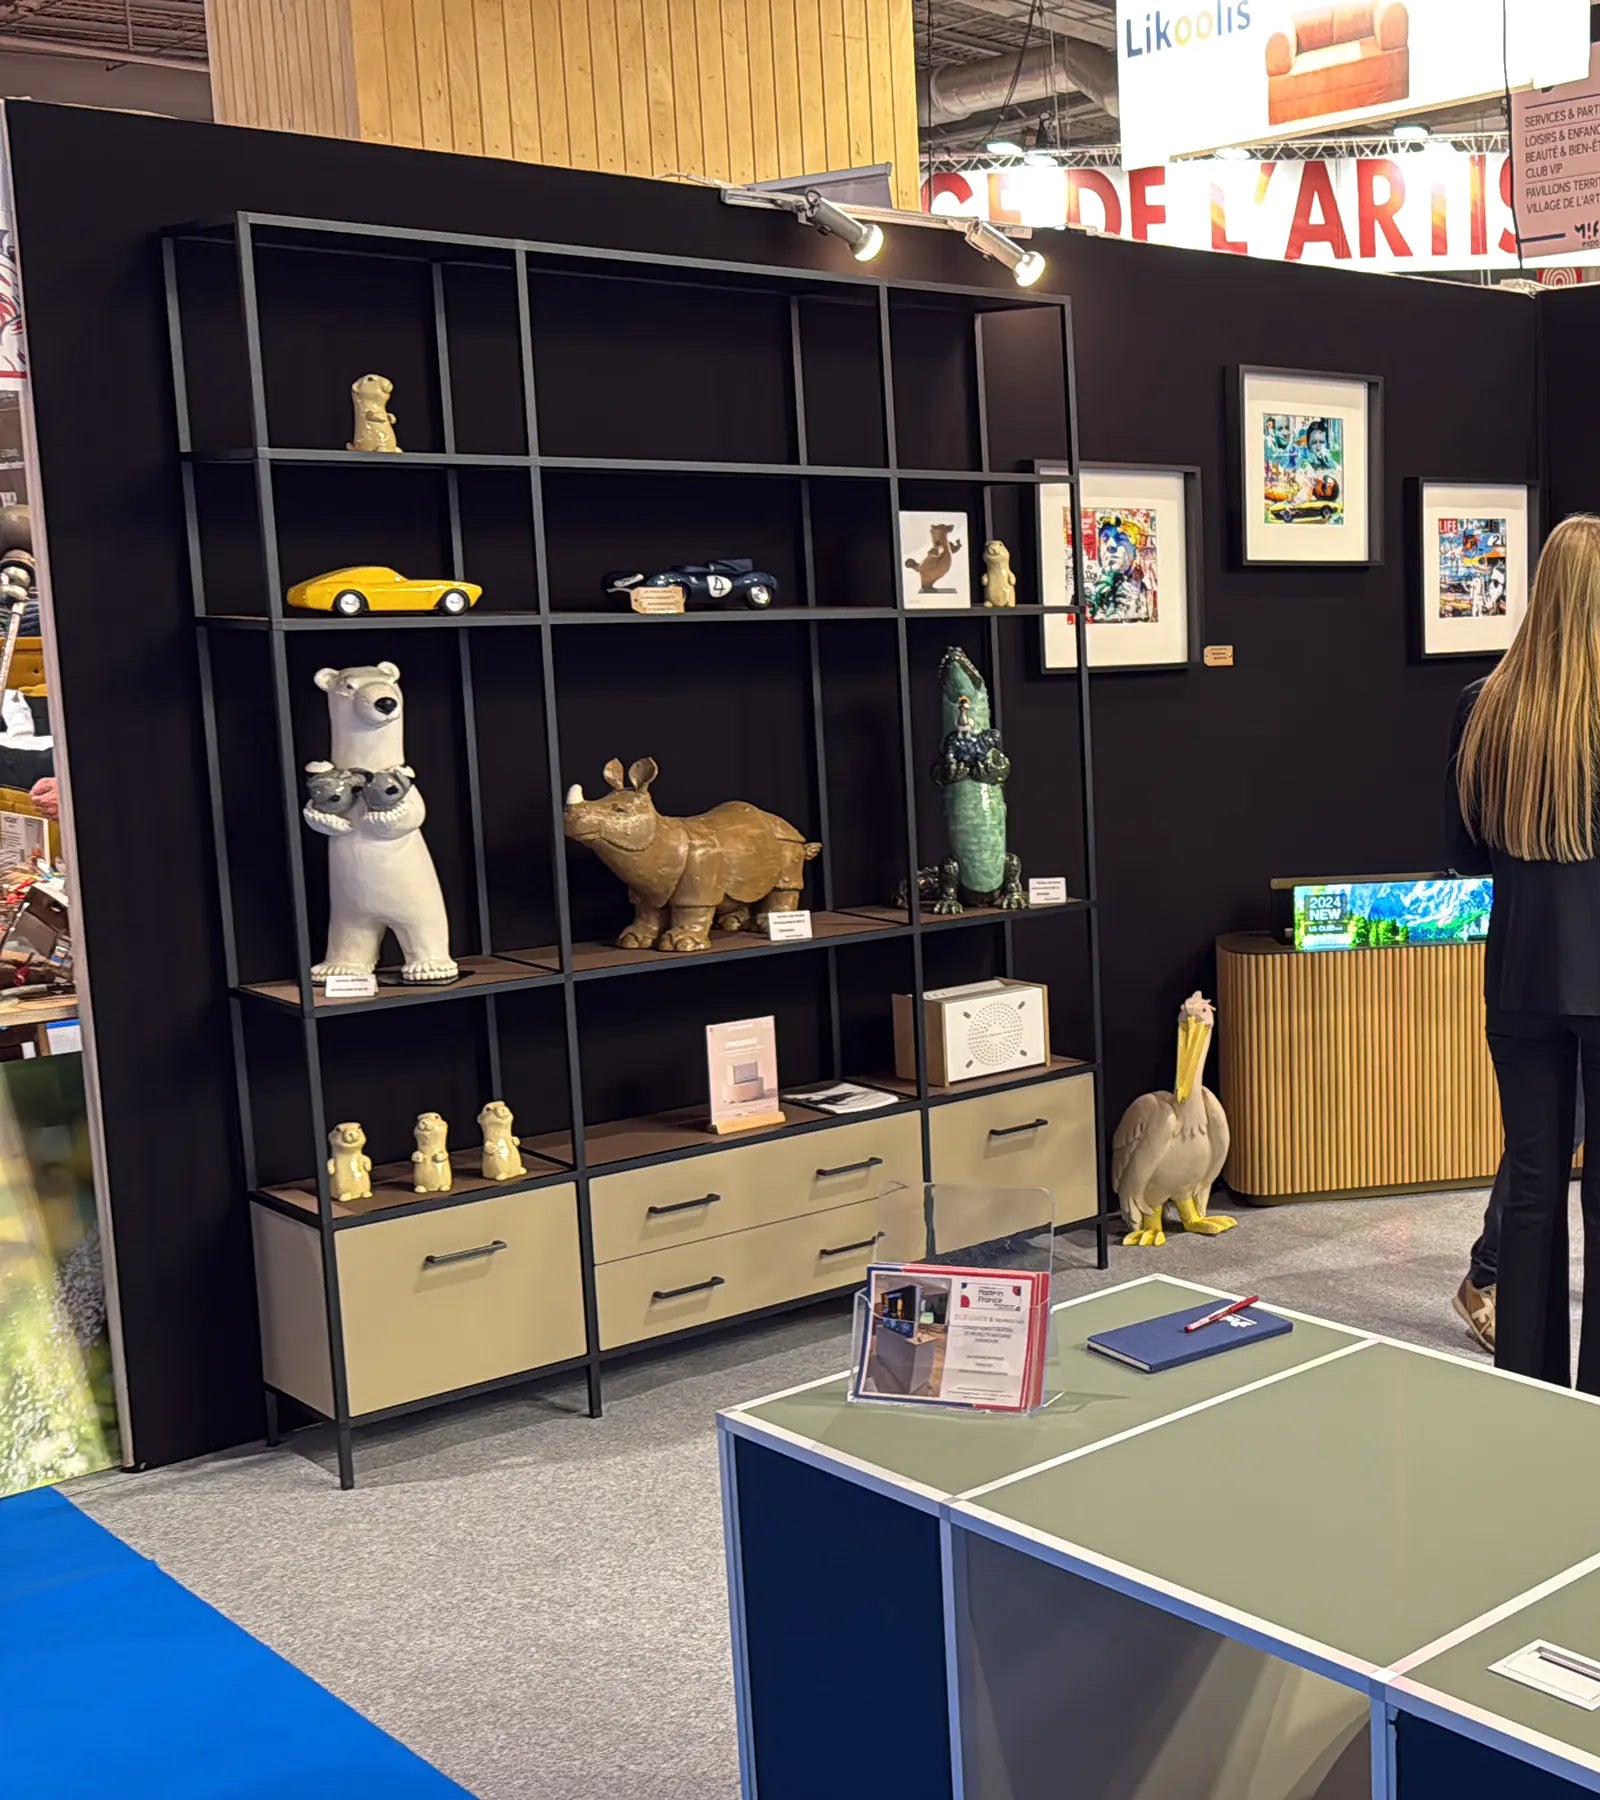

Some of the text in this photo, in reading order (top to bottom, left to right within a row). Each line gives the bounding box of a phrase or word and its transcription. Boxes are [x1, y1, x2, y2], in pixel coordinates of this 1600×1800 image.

[1126, 0, 1250, 58] Likoolis
[1525, 110, 1566, 128] SERVICES
[1569, 108, 1574, 120] &
[1525, 131, 1557, 147] LOISIRS
[1559, 129, 1565, 141] &
[1526, 147, 1558, 163] BEAUTÉ
[1560, 146, 1566, 157] &
[1526, 164, 1563, 179] CLUB VIP
[1526, 181, 1571, 198] PAVILLONS
[1066, 164, 1166, 241] DE
[1527, 199, 1561, 214] VILLAGE
[1564, 196, 1574, 207] DE
[1439, 520, 1458, 534] LIFE
[714, 577, 726, 594] 4
[1310, 896, 1341, 908] 2024
[1309, 909, 1341, 920] NEW
